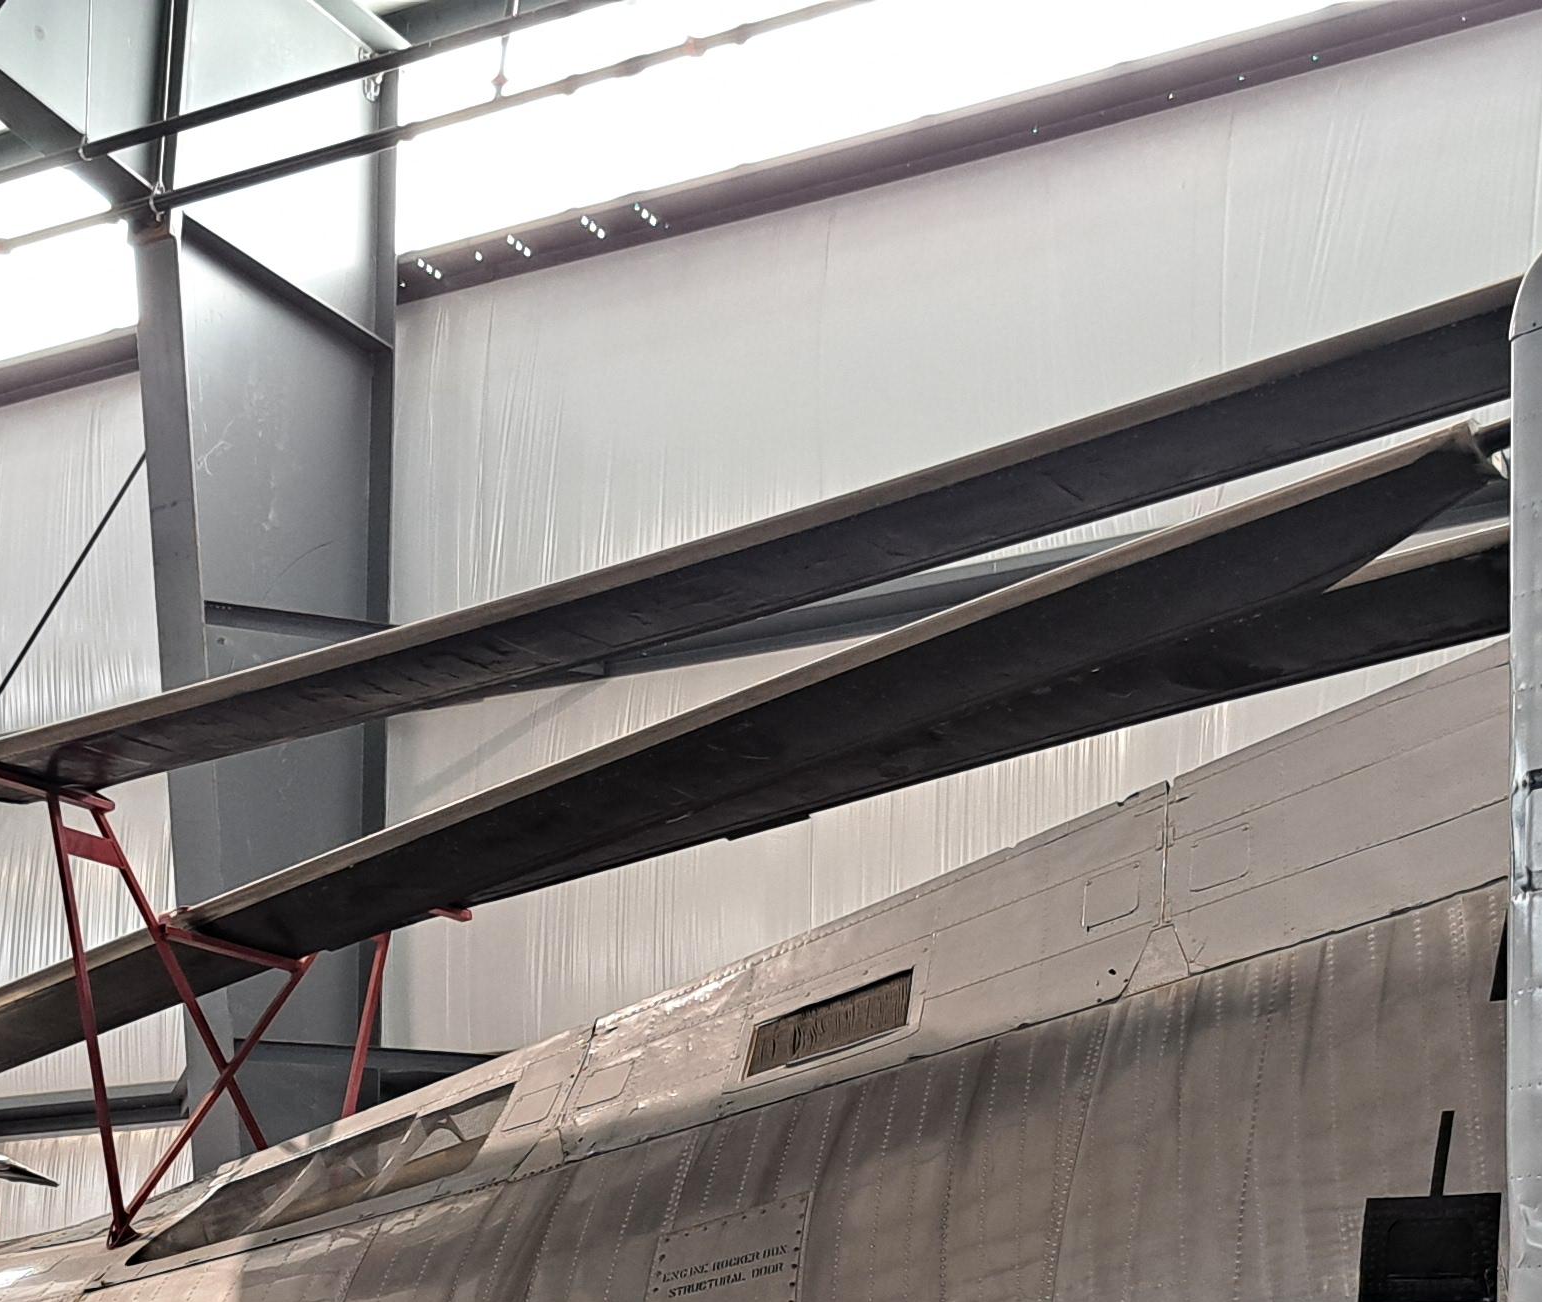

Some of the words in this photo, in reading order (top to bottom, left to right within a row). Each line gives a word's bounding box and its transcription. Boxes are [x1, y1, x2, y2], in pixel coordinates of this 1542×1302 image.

[662, 1262, 710, 1283] ENGINE
[712, 1251, 761, 1272] ROCKER
[762, 1244, 789, 1260] BOX
[667, 1271, 747, 1298] STRUCTURAL
[751, 1262, 785, 1279] DOOR
